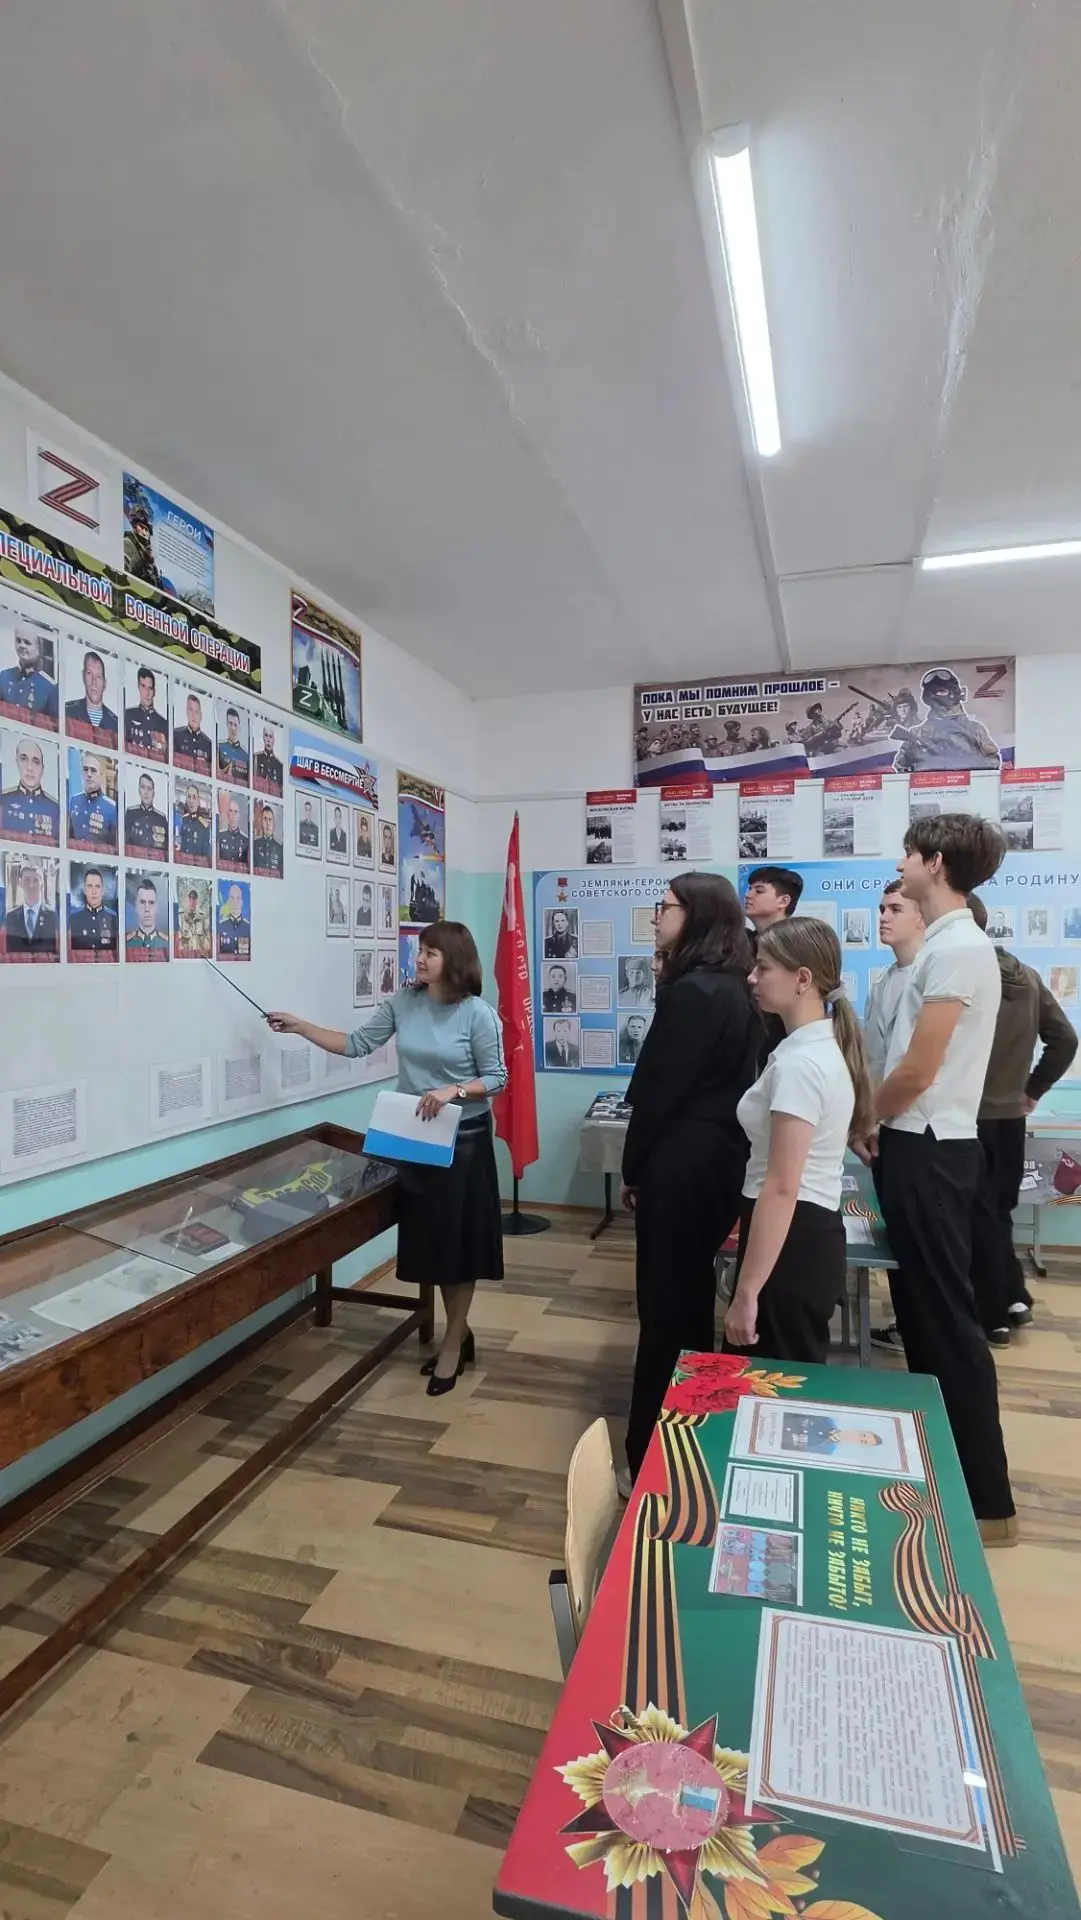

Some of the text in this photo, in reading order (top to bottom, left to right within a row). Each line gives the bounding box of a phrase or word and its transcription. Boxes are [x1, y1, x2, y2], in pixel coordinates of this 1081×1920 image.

[167, 510, 202, 540] ГЕРОИ
[0, 530, 113, 608] ПЕЦИАЛЬНОЙ
[125, 593, 189, 645] ВОЕННОЙ
[190, 628, 250, 675] ОПЕРАЦИИ
[642, 692, 673, 704] ПОКА
[679, 690, 700, 702] МЫ
[706, 685, 758, 700] ПОМНИМ
[764, 680, 824, 695] ПРОШЛОЕ
[643, 701, 778, 722] У НАС ЕСТЬ БУДУЩЕЕ!
[297, 756, 364, 789] ШАГ В БЕССМЕРТИЕ
[571, 889, 641, 899] СОВЕТСКОГО
[581, 877, 669, 888] ЗЕМЛЯКИ-ГЕРОИ
[821, 879, 855, 891] ОНИ
[1005, 873, 1080, 887] РОДИНУ
[828, 1491, 847, 1611] НИЧТО НЕ ЗАБЫТО!
[849, 1496, 872, 1607] НИКТО НЕ ЗАБЫТ,
